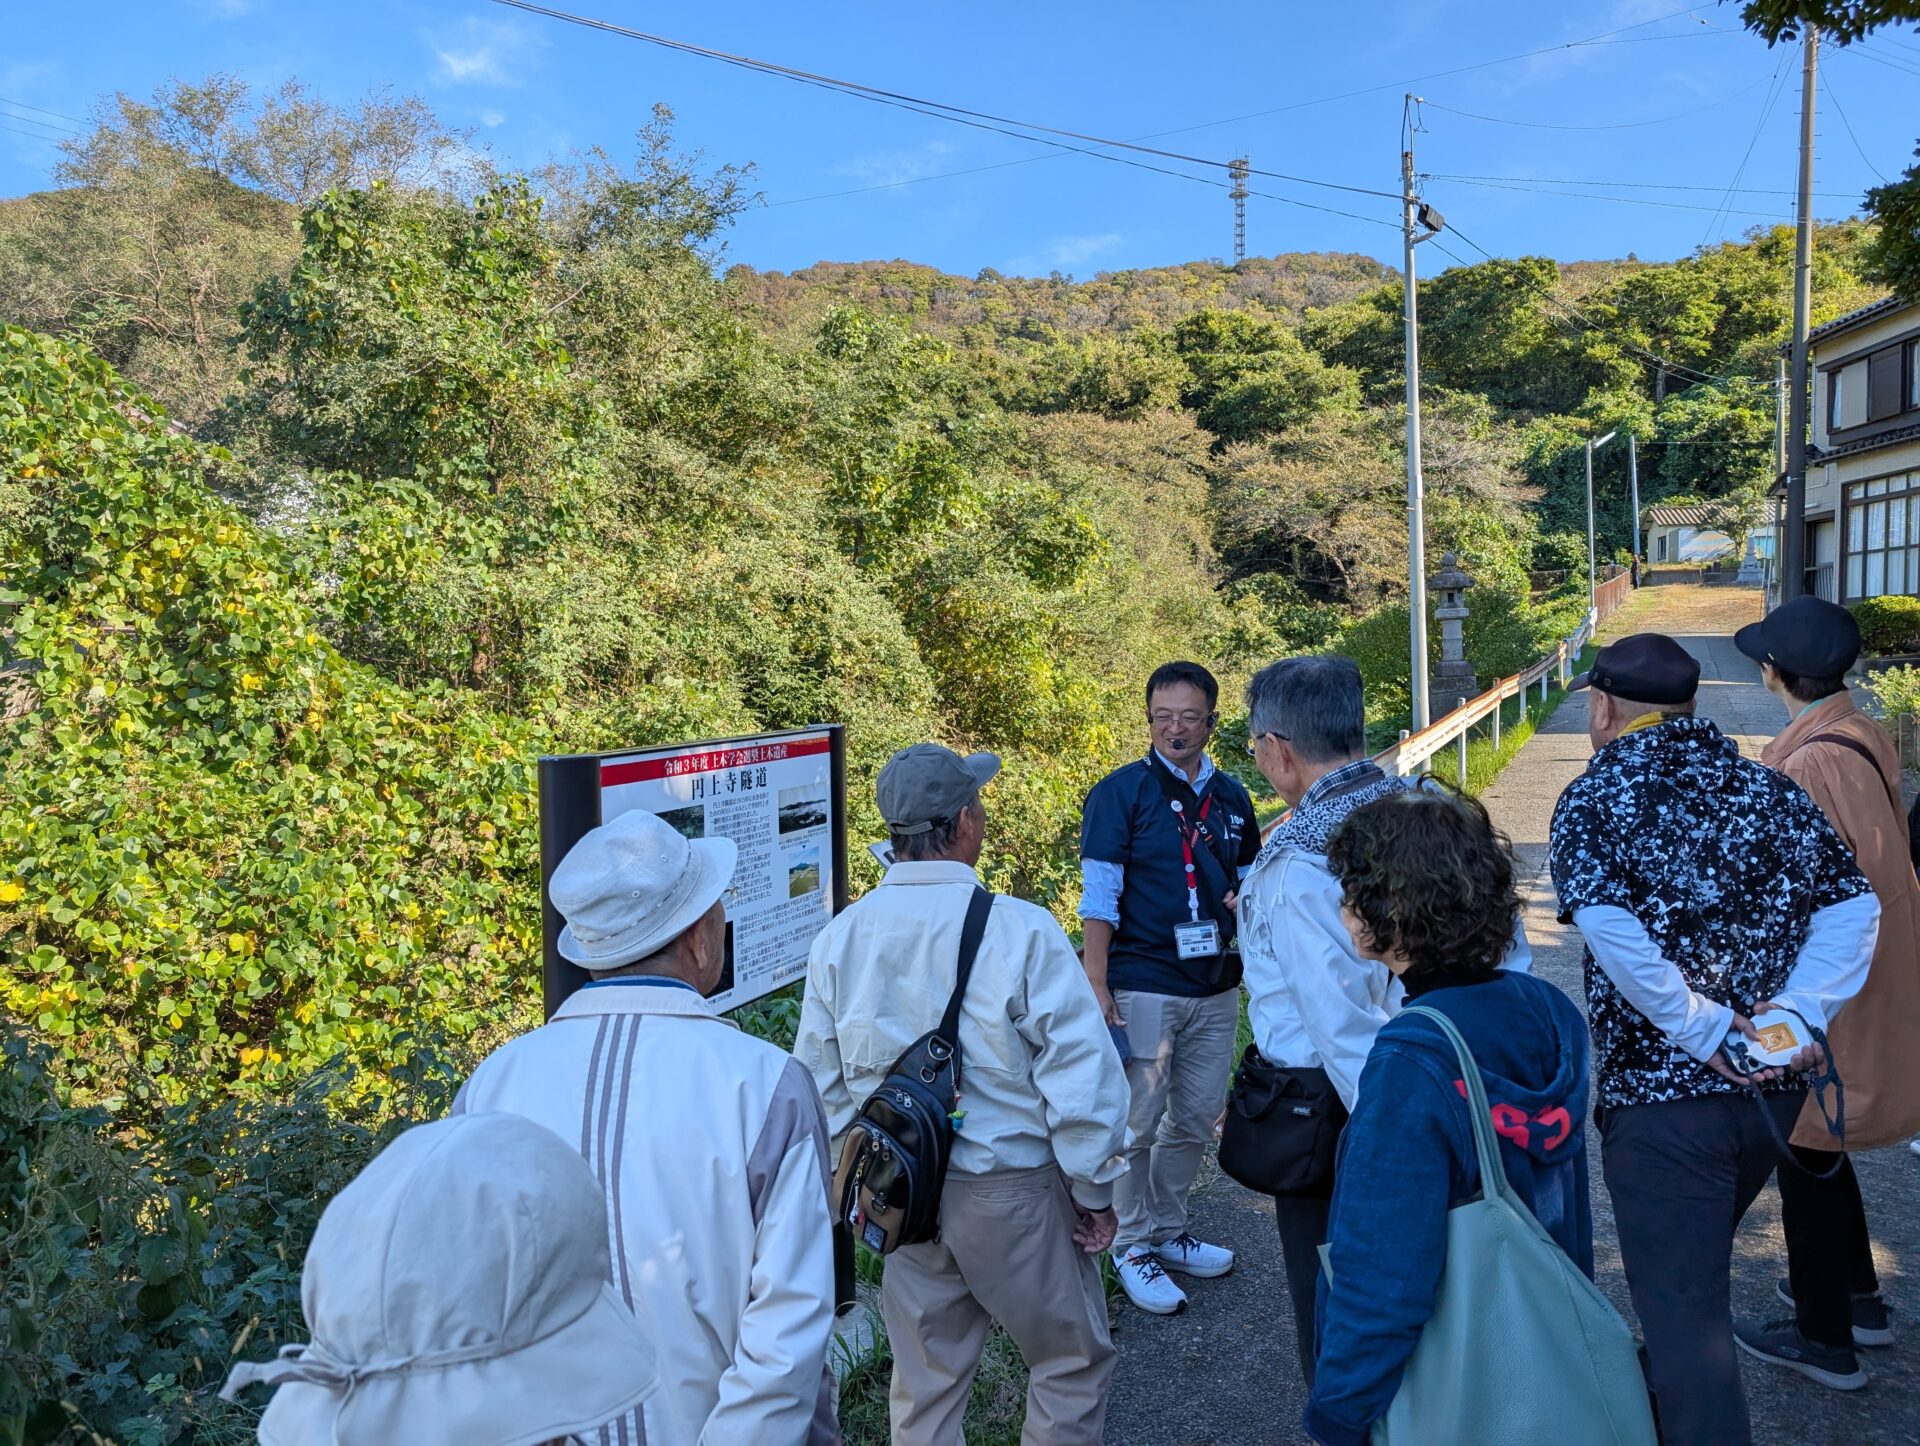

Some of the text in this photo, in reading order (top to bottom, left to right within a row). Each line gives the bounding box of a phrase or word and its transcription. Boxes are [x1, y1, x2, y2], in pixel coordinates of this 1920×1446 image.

[664, 757, 709, 775] 令和3年度
[692, 767, 768, 801] 円上寺隧道
